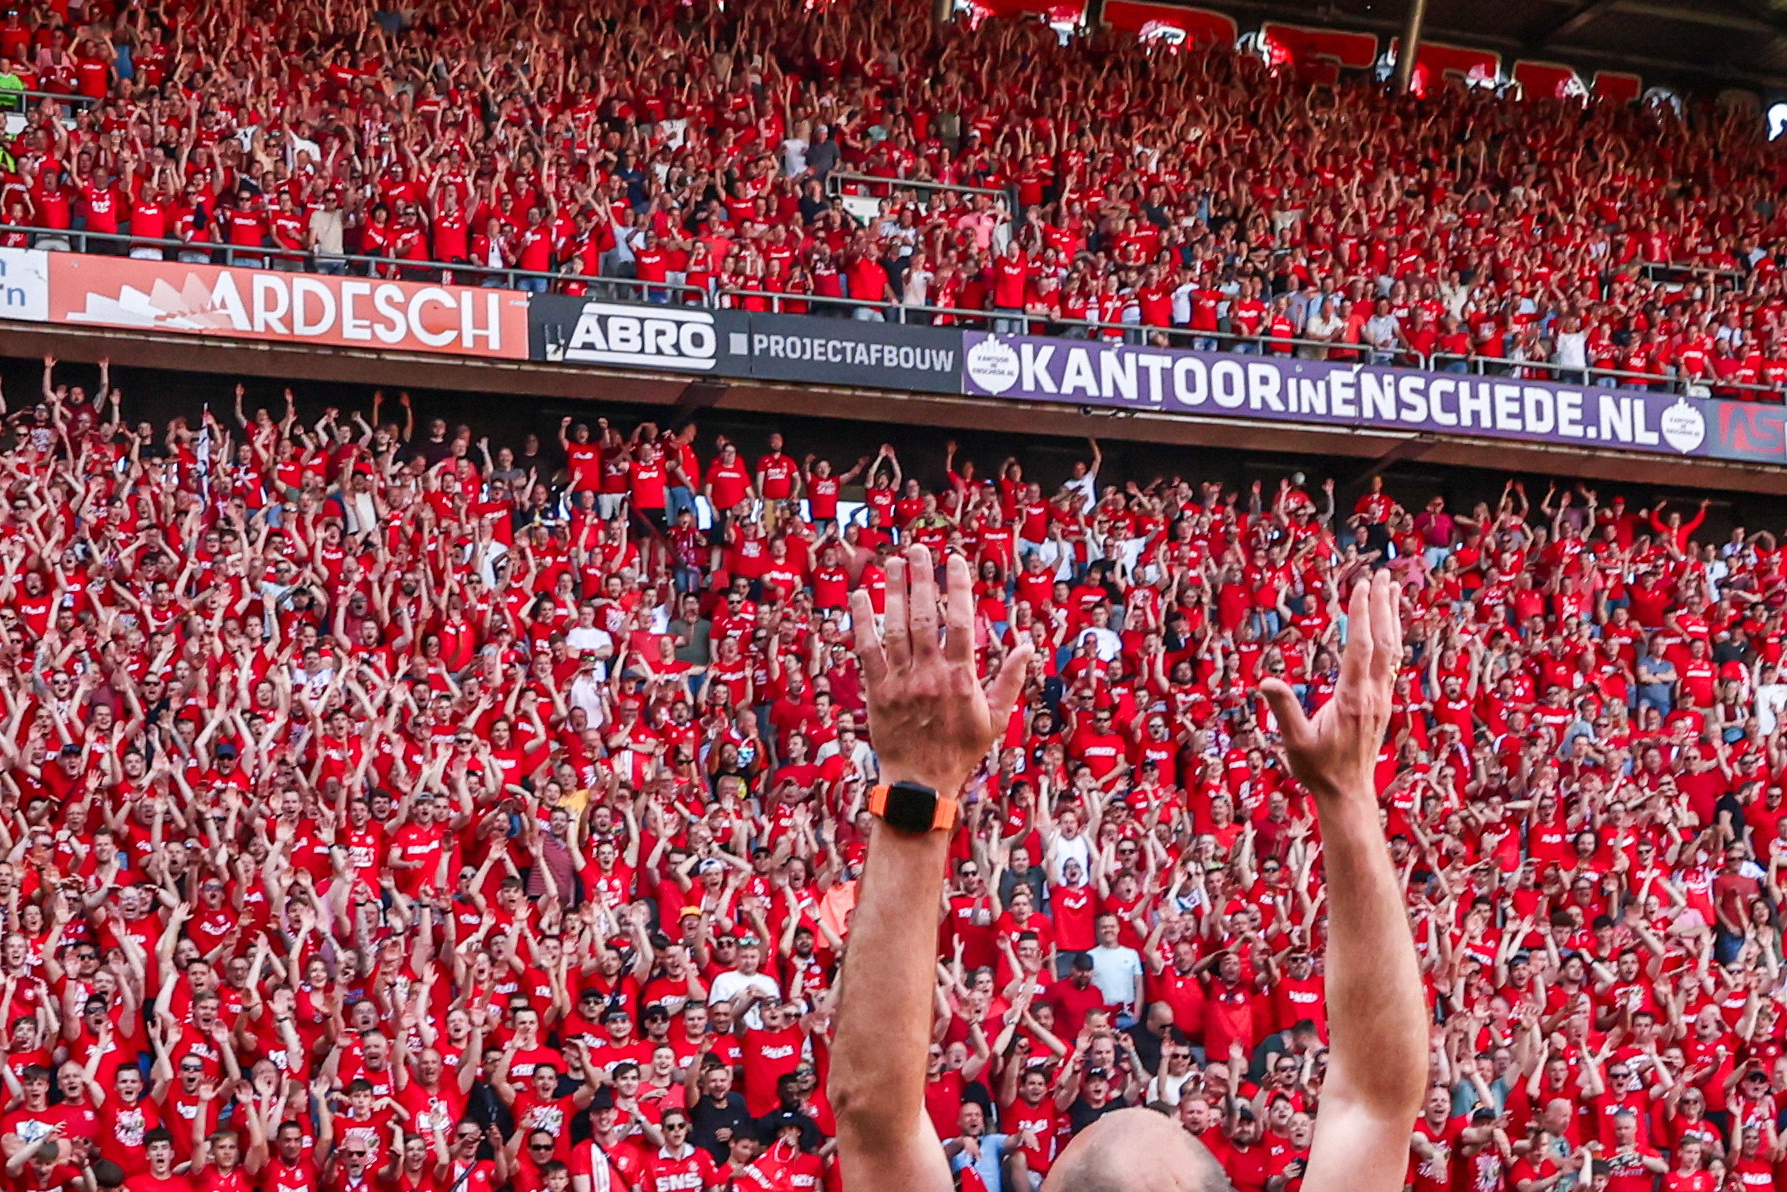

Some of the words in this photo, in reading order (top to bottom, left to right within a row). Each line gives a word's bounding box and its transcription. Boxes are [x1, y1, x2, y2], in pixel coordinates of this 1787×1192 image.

[211, 270, 502, 350] ARDESCH
[568, 313, 717, 359] ABRO
[752, 333, 955, 373] PROJECTAFBOUW
[656, 1172, 703, 1192] SNS
